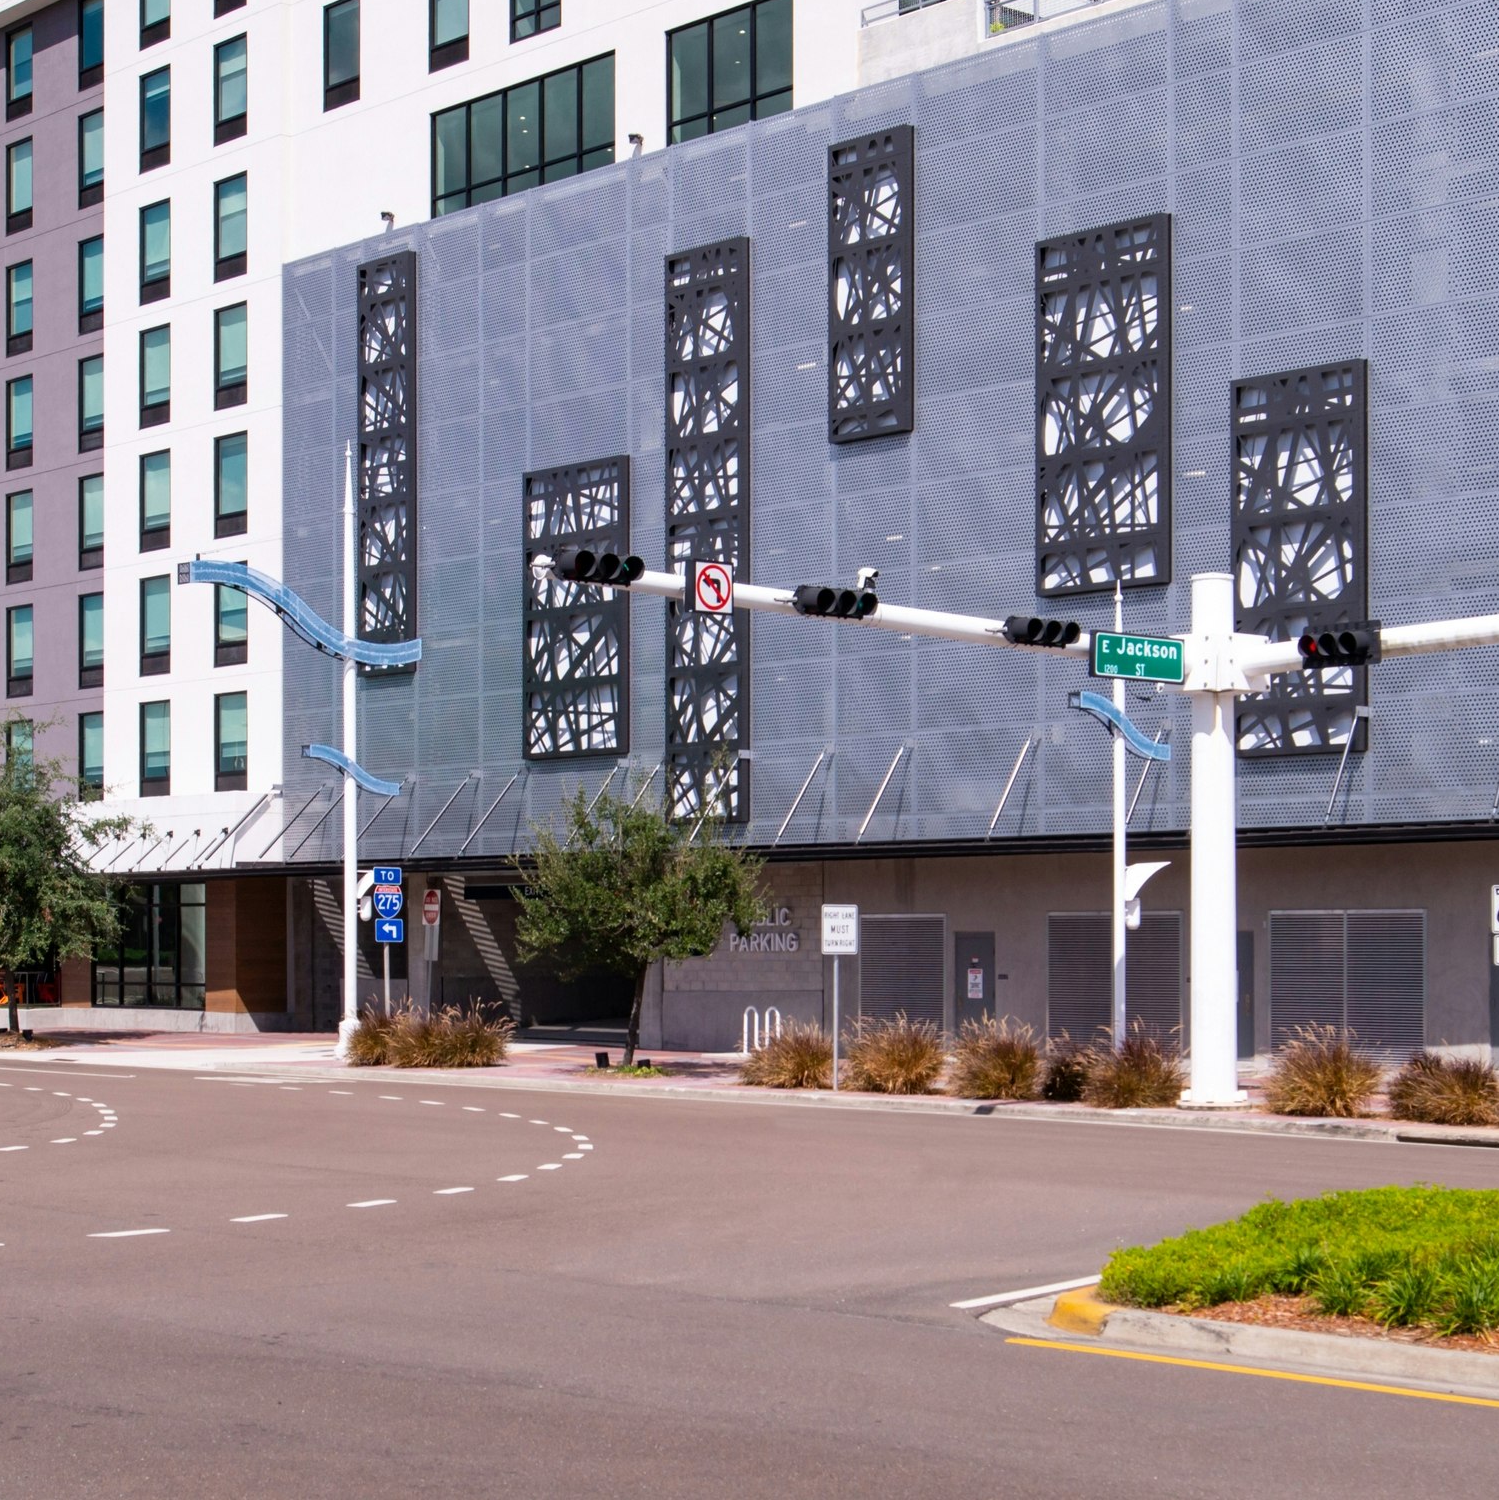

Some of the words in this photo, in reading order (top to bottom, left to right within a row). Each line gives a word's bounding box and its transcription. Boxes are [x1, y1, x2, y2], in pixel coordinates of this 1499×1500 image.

[1102, 639, 1110, 653] E
[1116, 637, 1177, 660] Jackson
[1104, 664, 1118, 674] 1200
[1135, 663, 1145, 676] ST
[380, 871, 394, 881] TO
[378, 894, 400, 910] 275
[830, 925, 849, 934] MUST
[729, 932, 799, 953] PARKING
[825, 939, 839, 947] TURN
[839, 939, 855, 947] RIGHT
